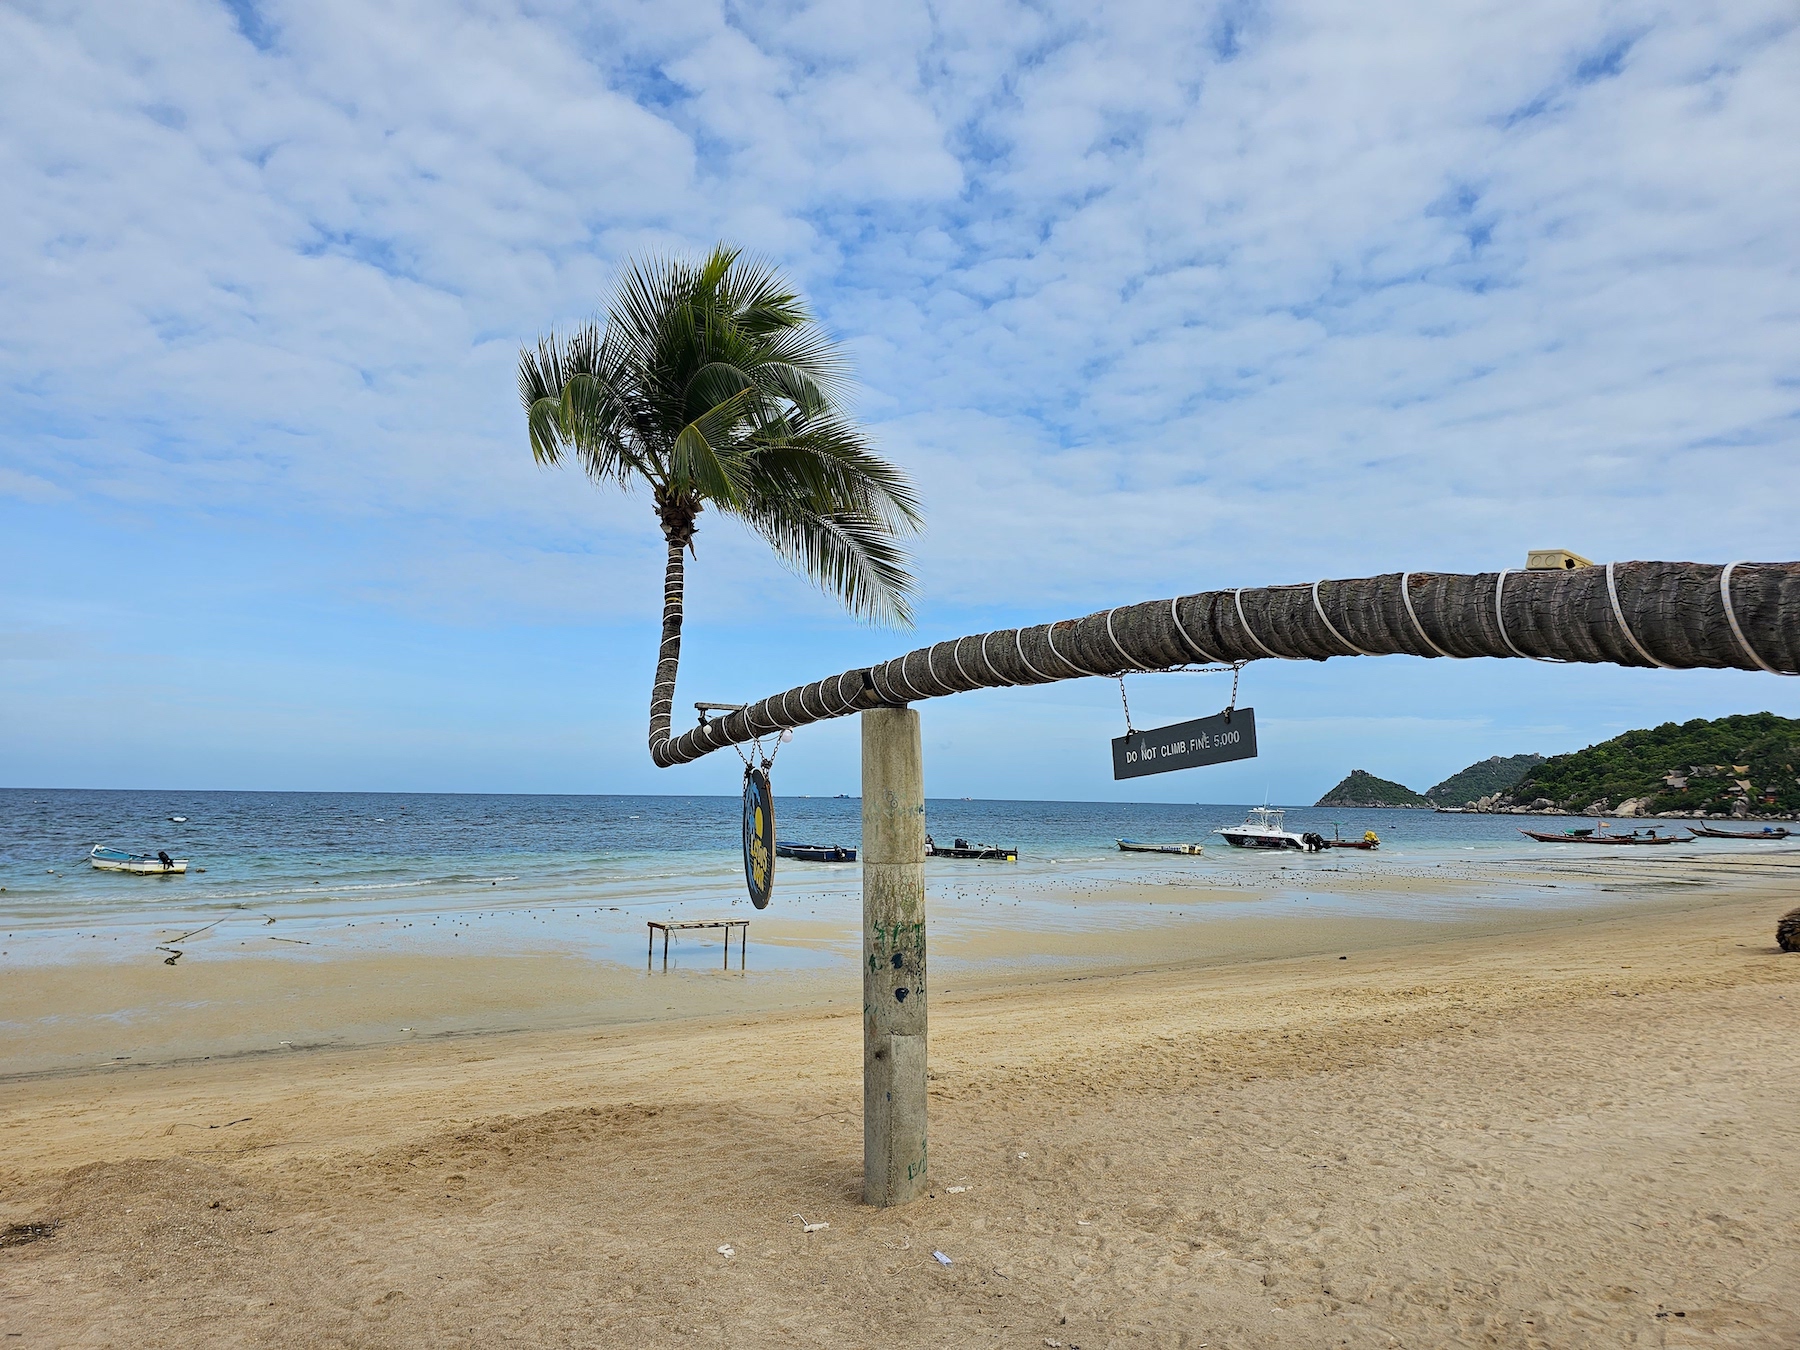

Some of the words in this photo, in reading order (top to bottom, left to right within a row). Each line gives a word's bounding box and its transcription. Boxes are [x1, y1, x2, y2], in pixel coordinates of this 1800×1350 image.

[1126, 751, 1138, 763] DO
[1141, 746, 1157, 761] NOT
[1161, 741, 1190, 757] CLIMB,
[1190, 736, 1211, 751] FINE
[1214, 730, 1240, 747] 5,000
